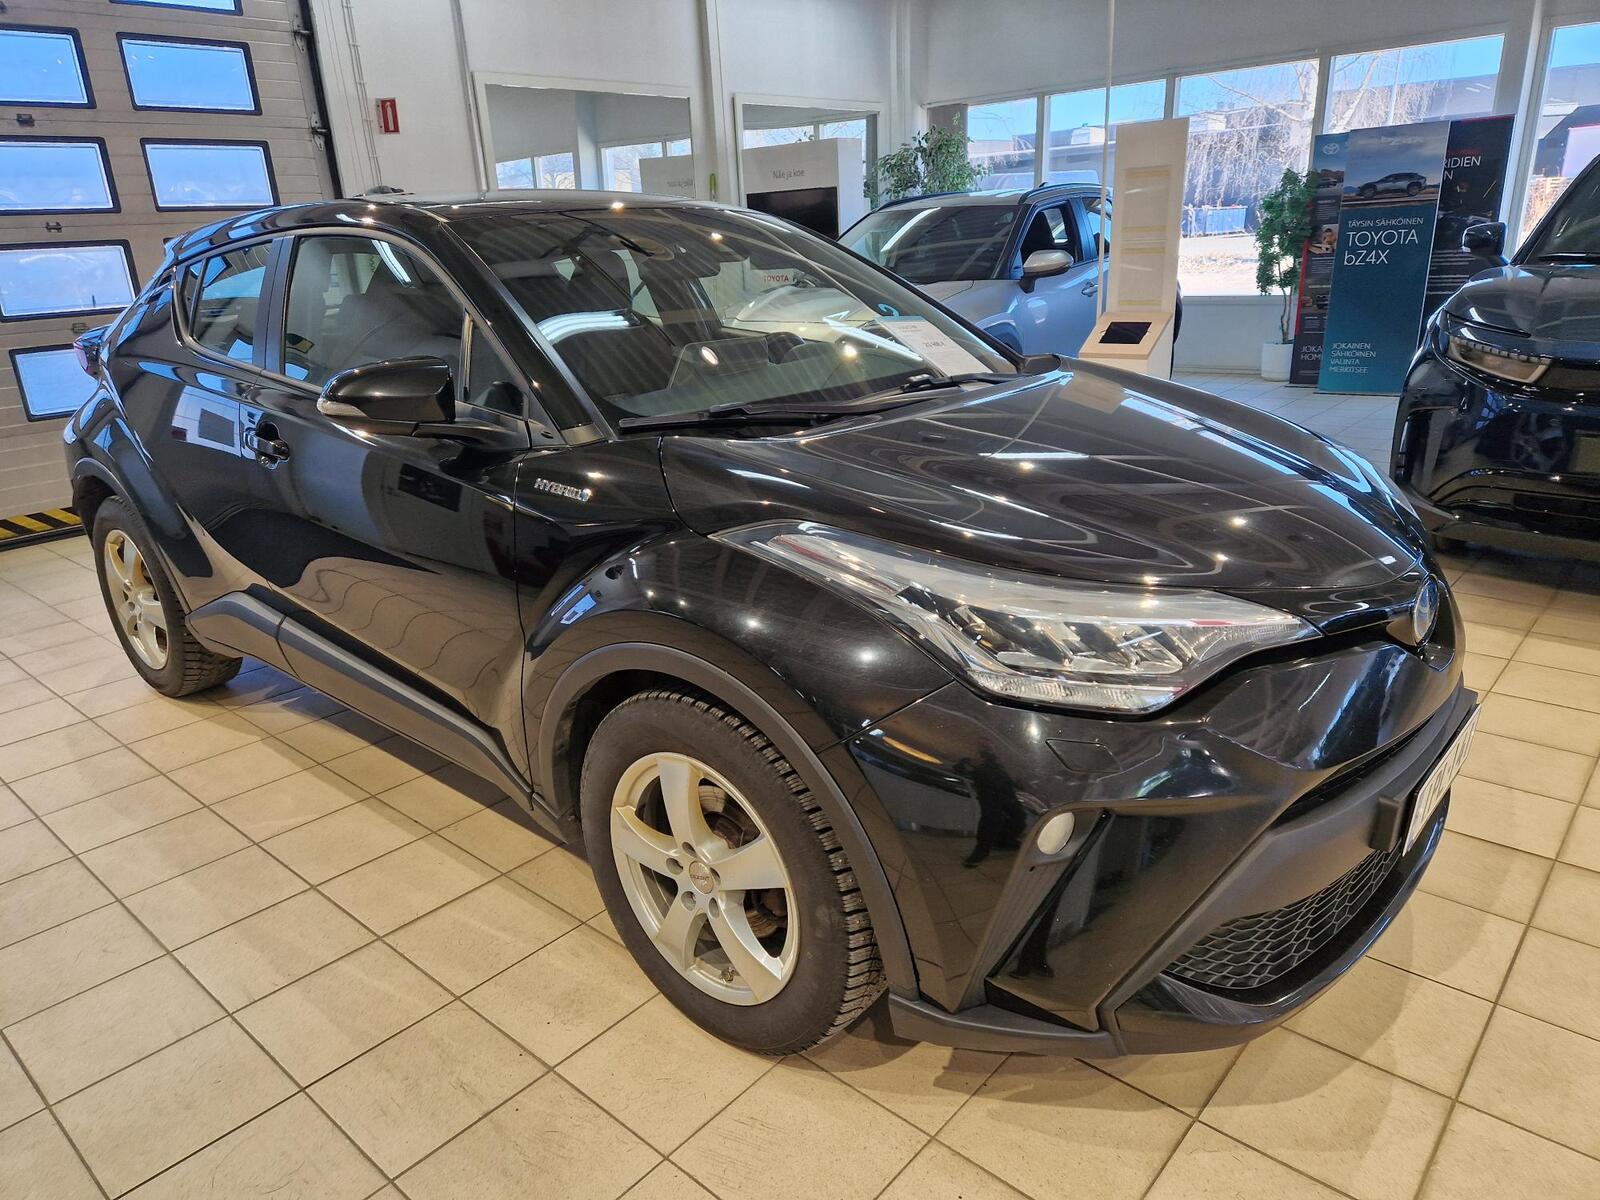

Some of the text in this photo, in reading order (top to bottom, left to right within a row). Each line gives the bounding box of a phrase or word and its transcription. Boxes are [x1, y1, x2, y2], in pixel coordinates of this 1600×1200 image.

[1444, 170, 1454, 180] N
[1346, 229, 1418, 247] TOYOTA
[1344, 250, 1390, 266] bZ4X
[1301, 345, 1323, 353] JOKA
[534, 478, 581, 501] HYBRID
